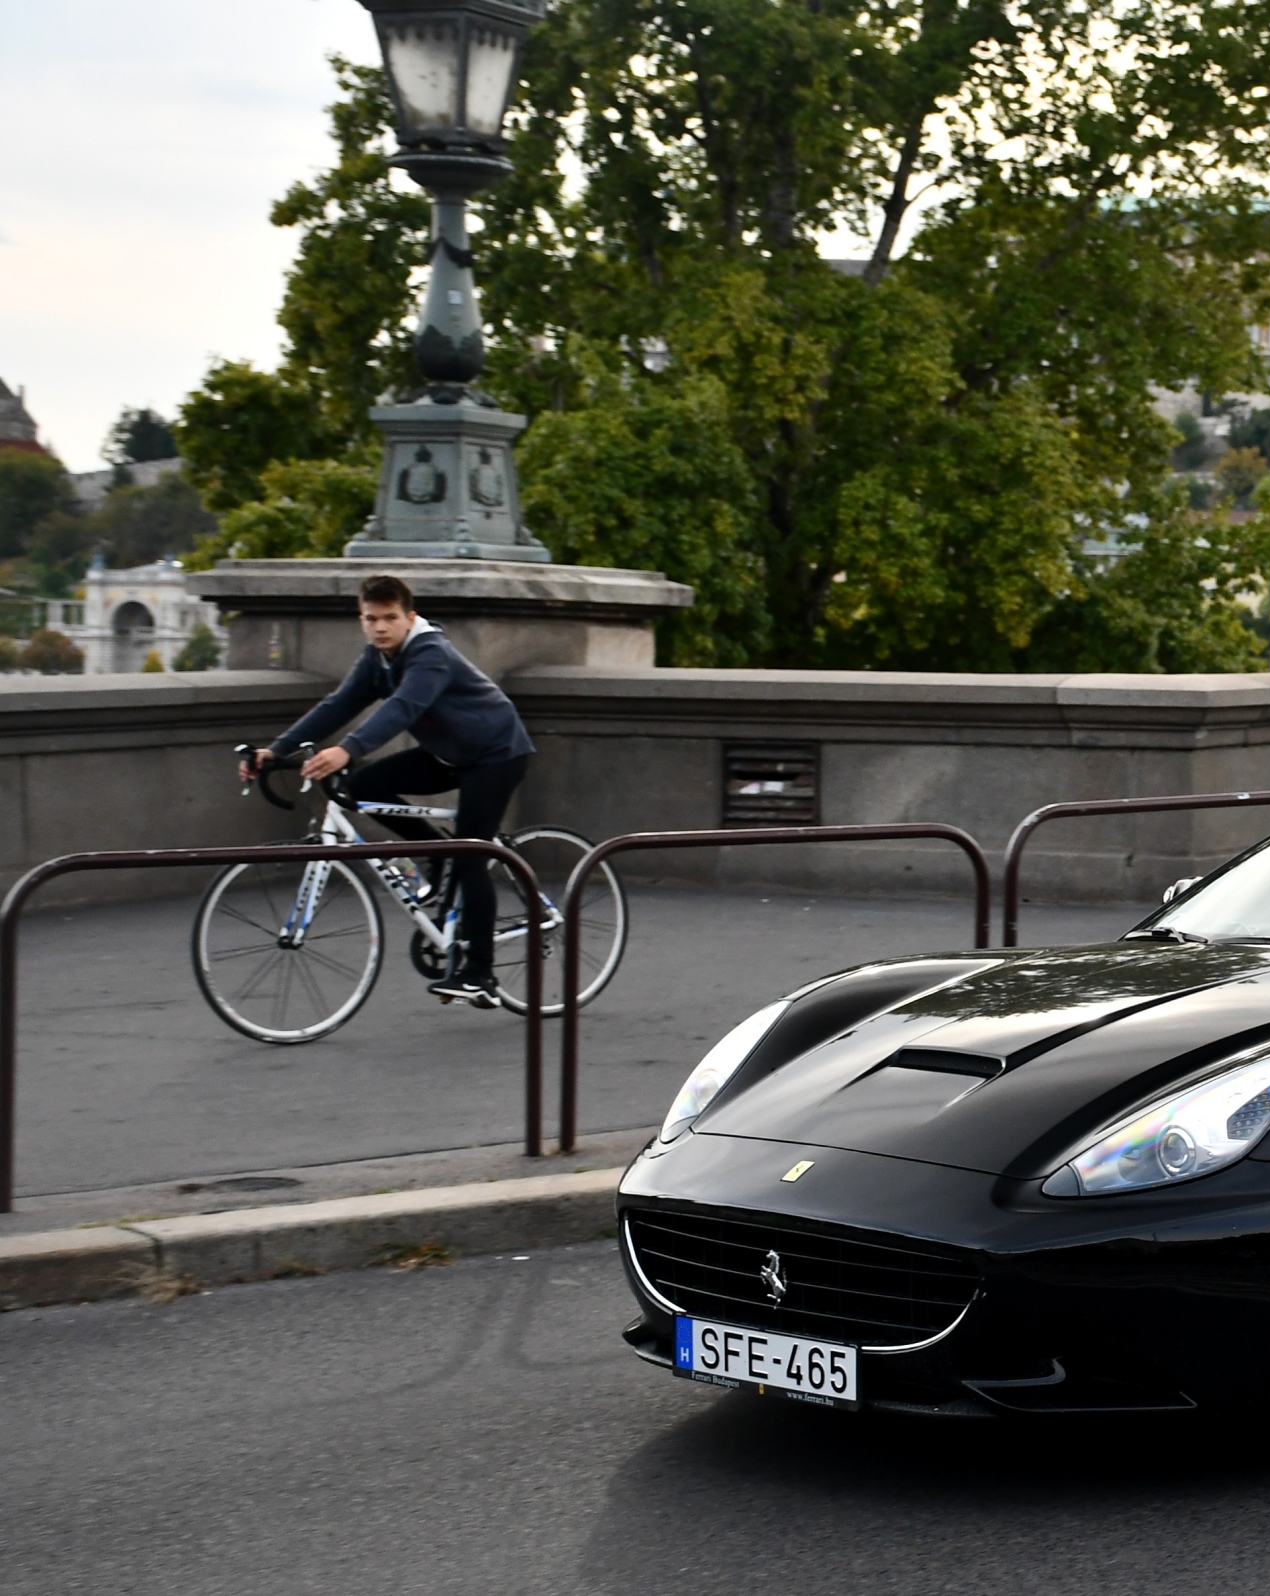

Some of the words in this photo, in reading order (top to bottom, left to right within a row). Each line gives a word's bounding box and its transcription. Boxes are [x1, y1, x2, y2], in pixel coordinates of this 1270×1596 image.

[680, 1347, 689, 1362] H
[700, 1328, 847, 1394] SFE-465
[691, 1371, 711, 1383] Ferrari
[712, 1375, 740, 1388] Budapest
[786, 1391, 834, 1406] www.ferrari.hu
